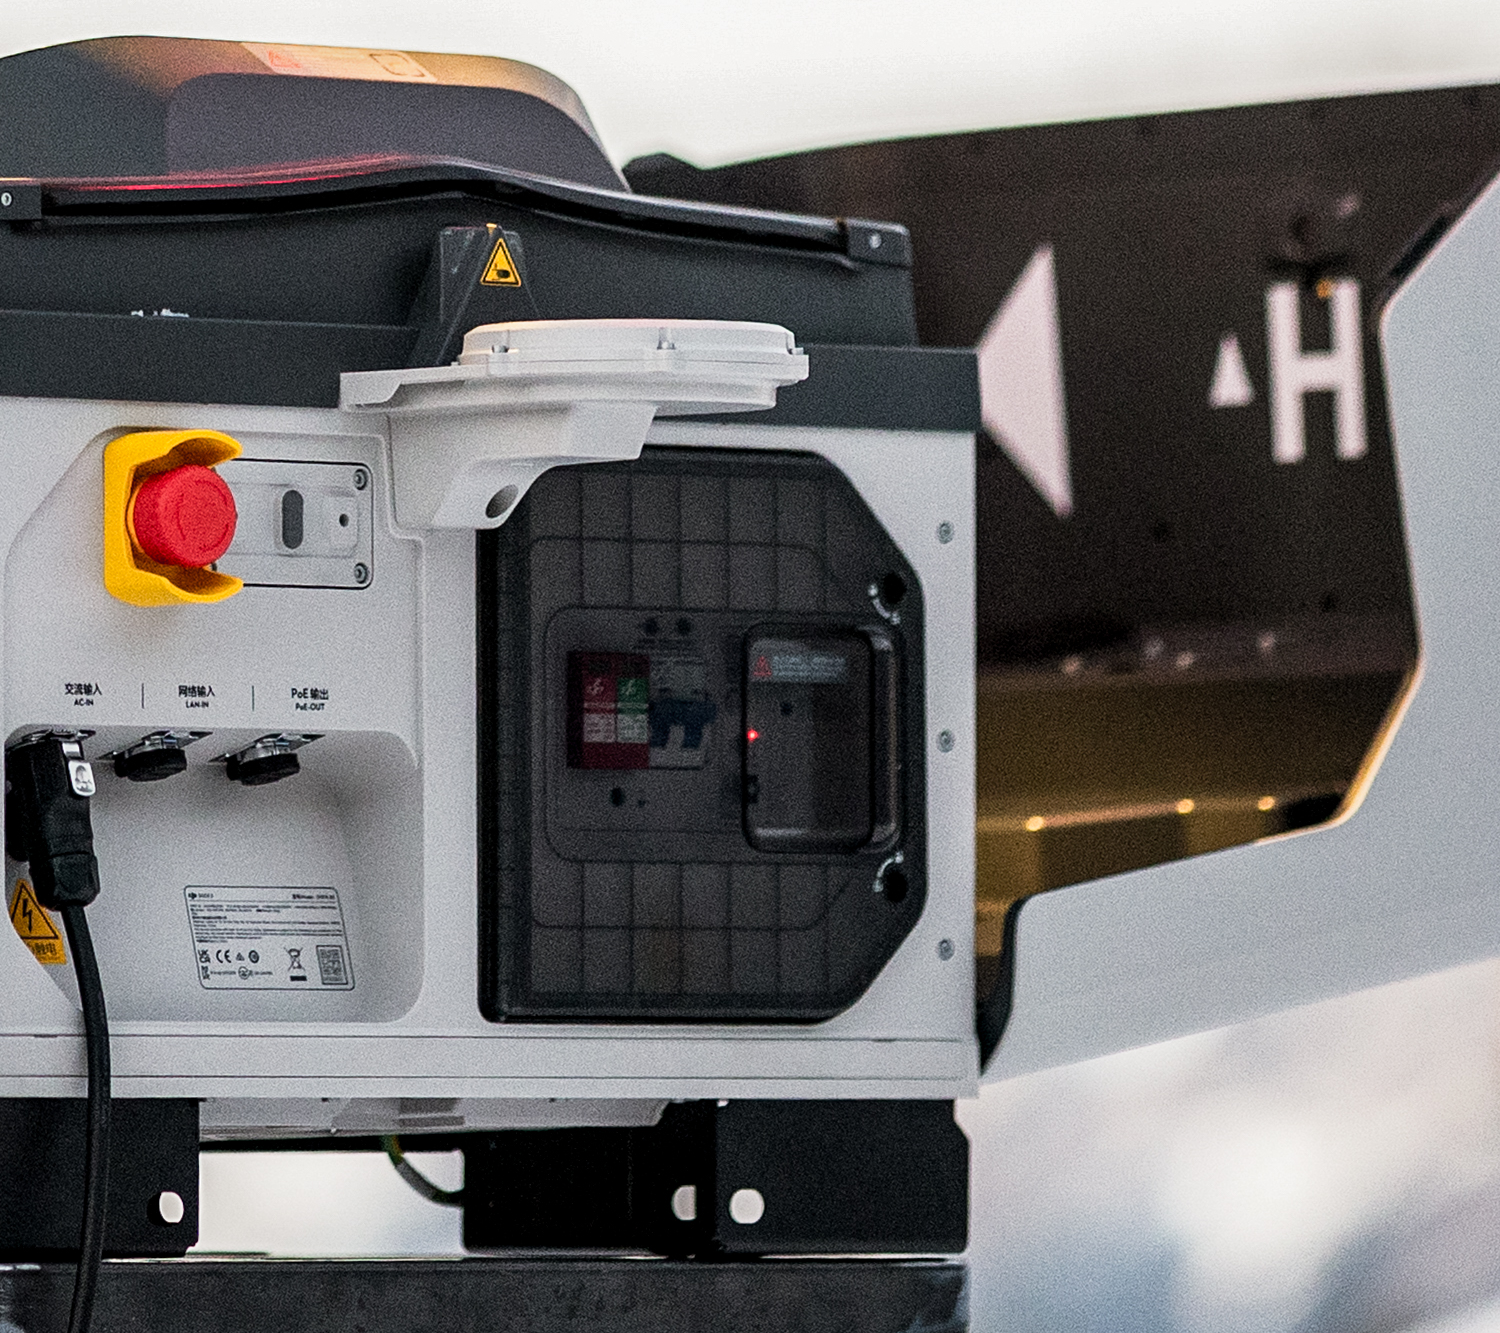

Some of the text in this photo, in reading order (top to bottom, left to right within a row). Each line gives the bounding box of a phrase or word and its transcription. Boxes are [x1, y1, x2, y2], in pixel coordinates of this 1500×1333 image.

[1266, 278, 1368, 466] H
[291, 687, 308, 699] PoE
[216, 949, 231, 963] CE
